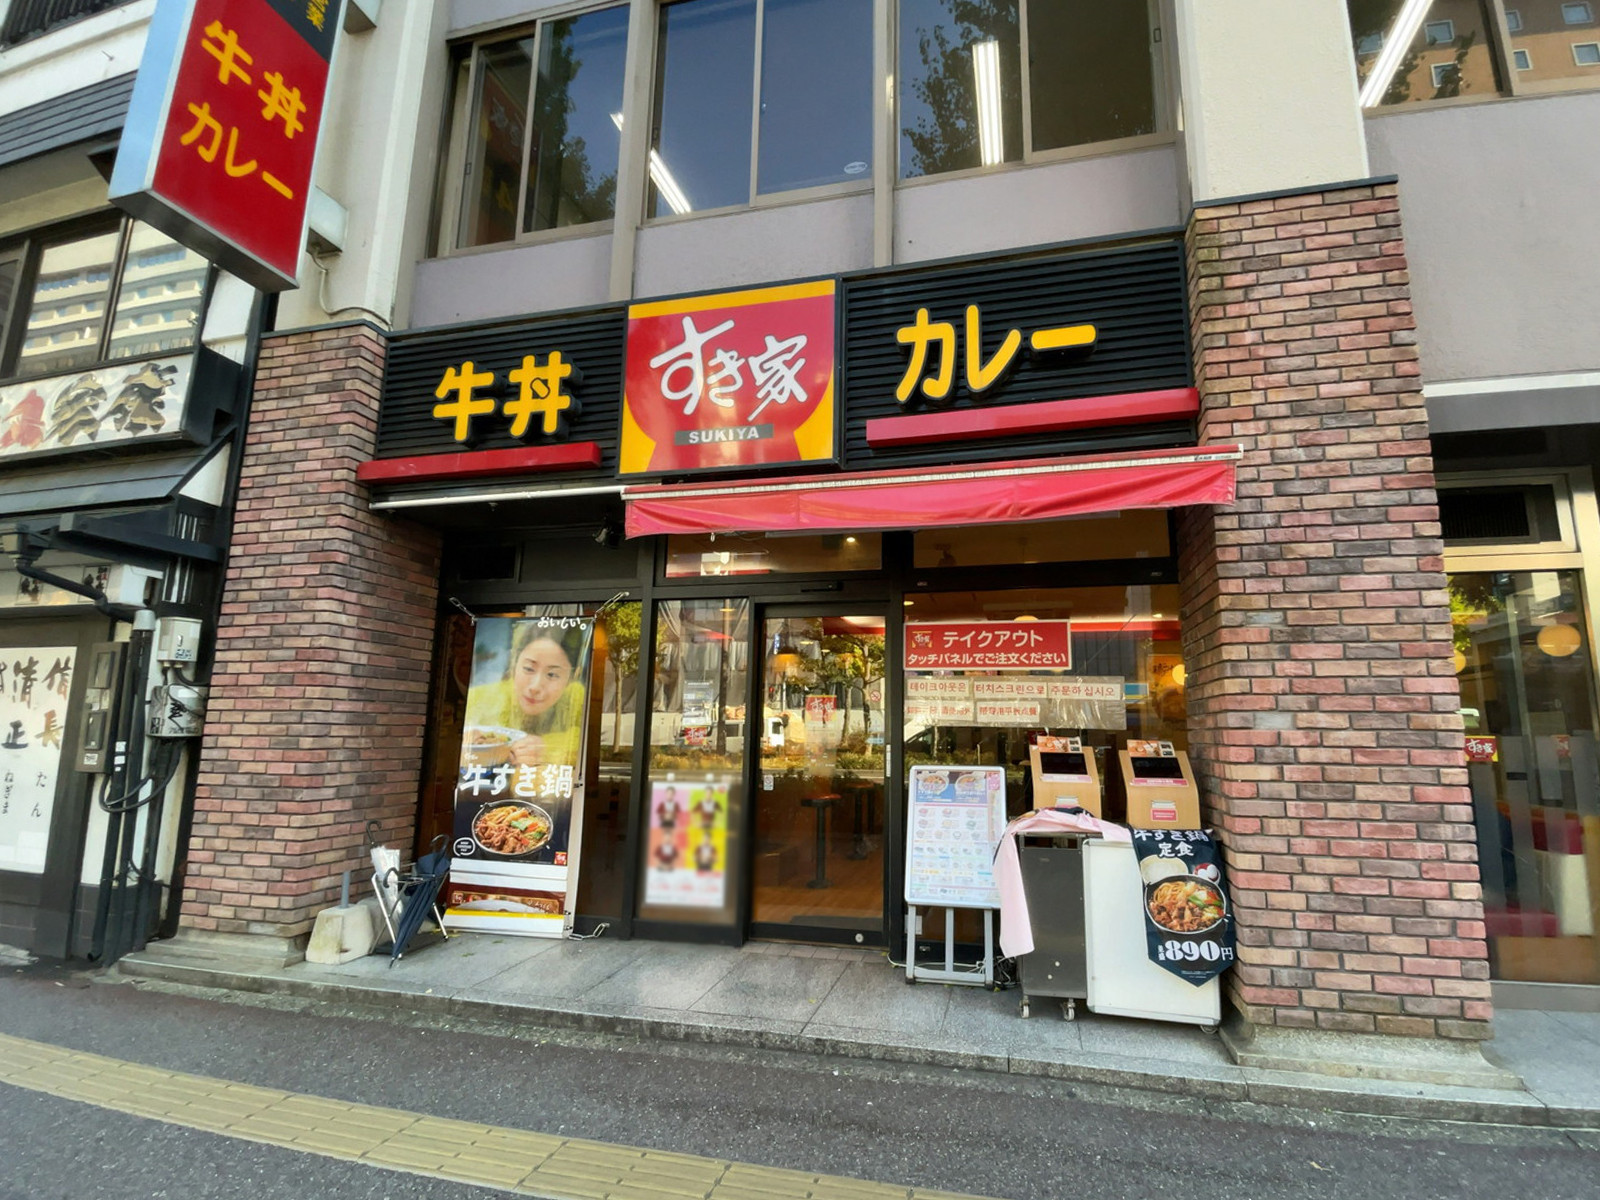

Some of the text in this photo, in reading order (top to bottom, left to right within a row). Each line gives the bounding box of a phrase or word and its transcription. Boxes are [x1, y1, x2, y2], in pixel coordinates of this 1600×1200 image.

[201, 19, 307, 139] 牛丼
[181, 102, 293, 199] カレー
[649, 316, 809, 422] すき家
[895, 303, 1097, 402] カレー
[433, 350, 574, 442] 牛丼
[688, 426, 760, 444] SUKIYA
[943, 630, 1044, 648] テイクアウト
[907, 652, 1067, 666] タッチパネルでご注文ください
[460, 763, 573, 799] 牛すき鍋
[1158, 841, 1194, 857] 定食
[1164, 940, 1234, 961] 890円
